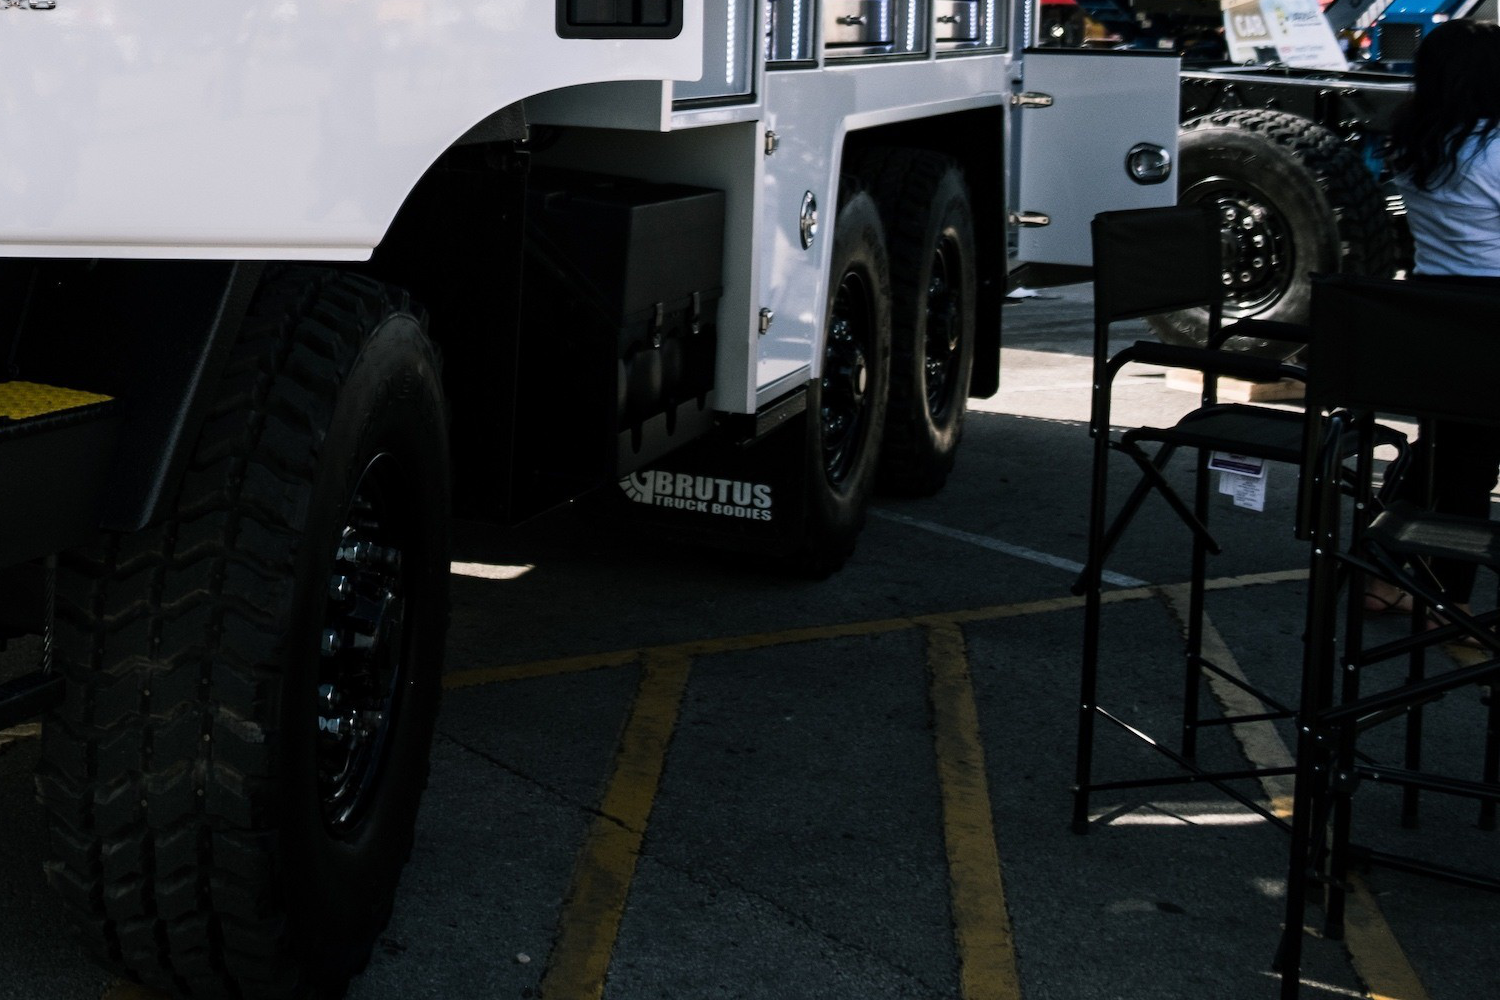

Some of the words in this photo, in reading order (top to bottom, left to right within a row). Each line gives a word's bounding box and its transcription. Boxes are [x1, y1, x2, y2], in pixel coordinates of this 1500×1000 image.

[655, 470, 773, 509] BRUTUS
[654, 494, 708, 513] TRUCK
[711, 502, 773, 522] BODIES
